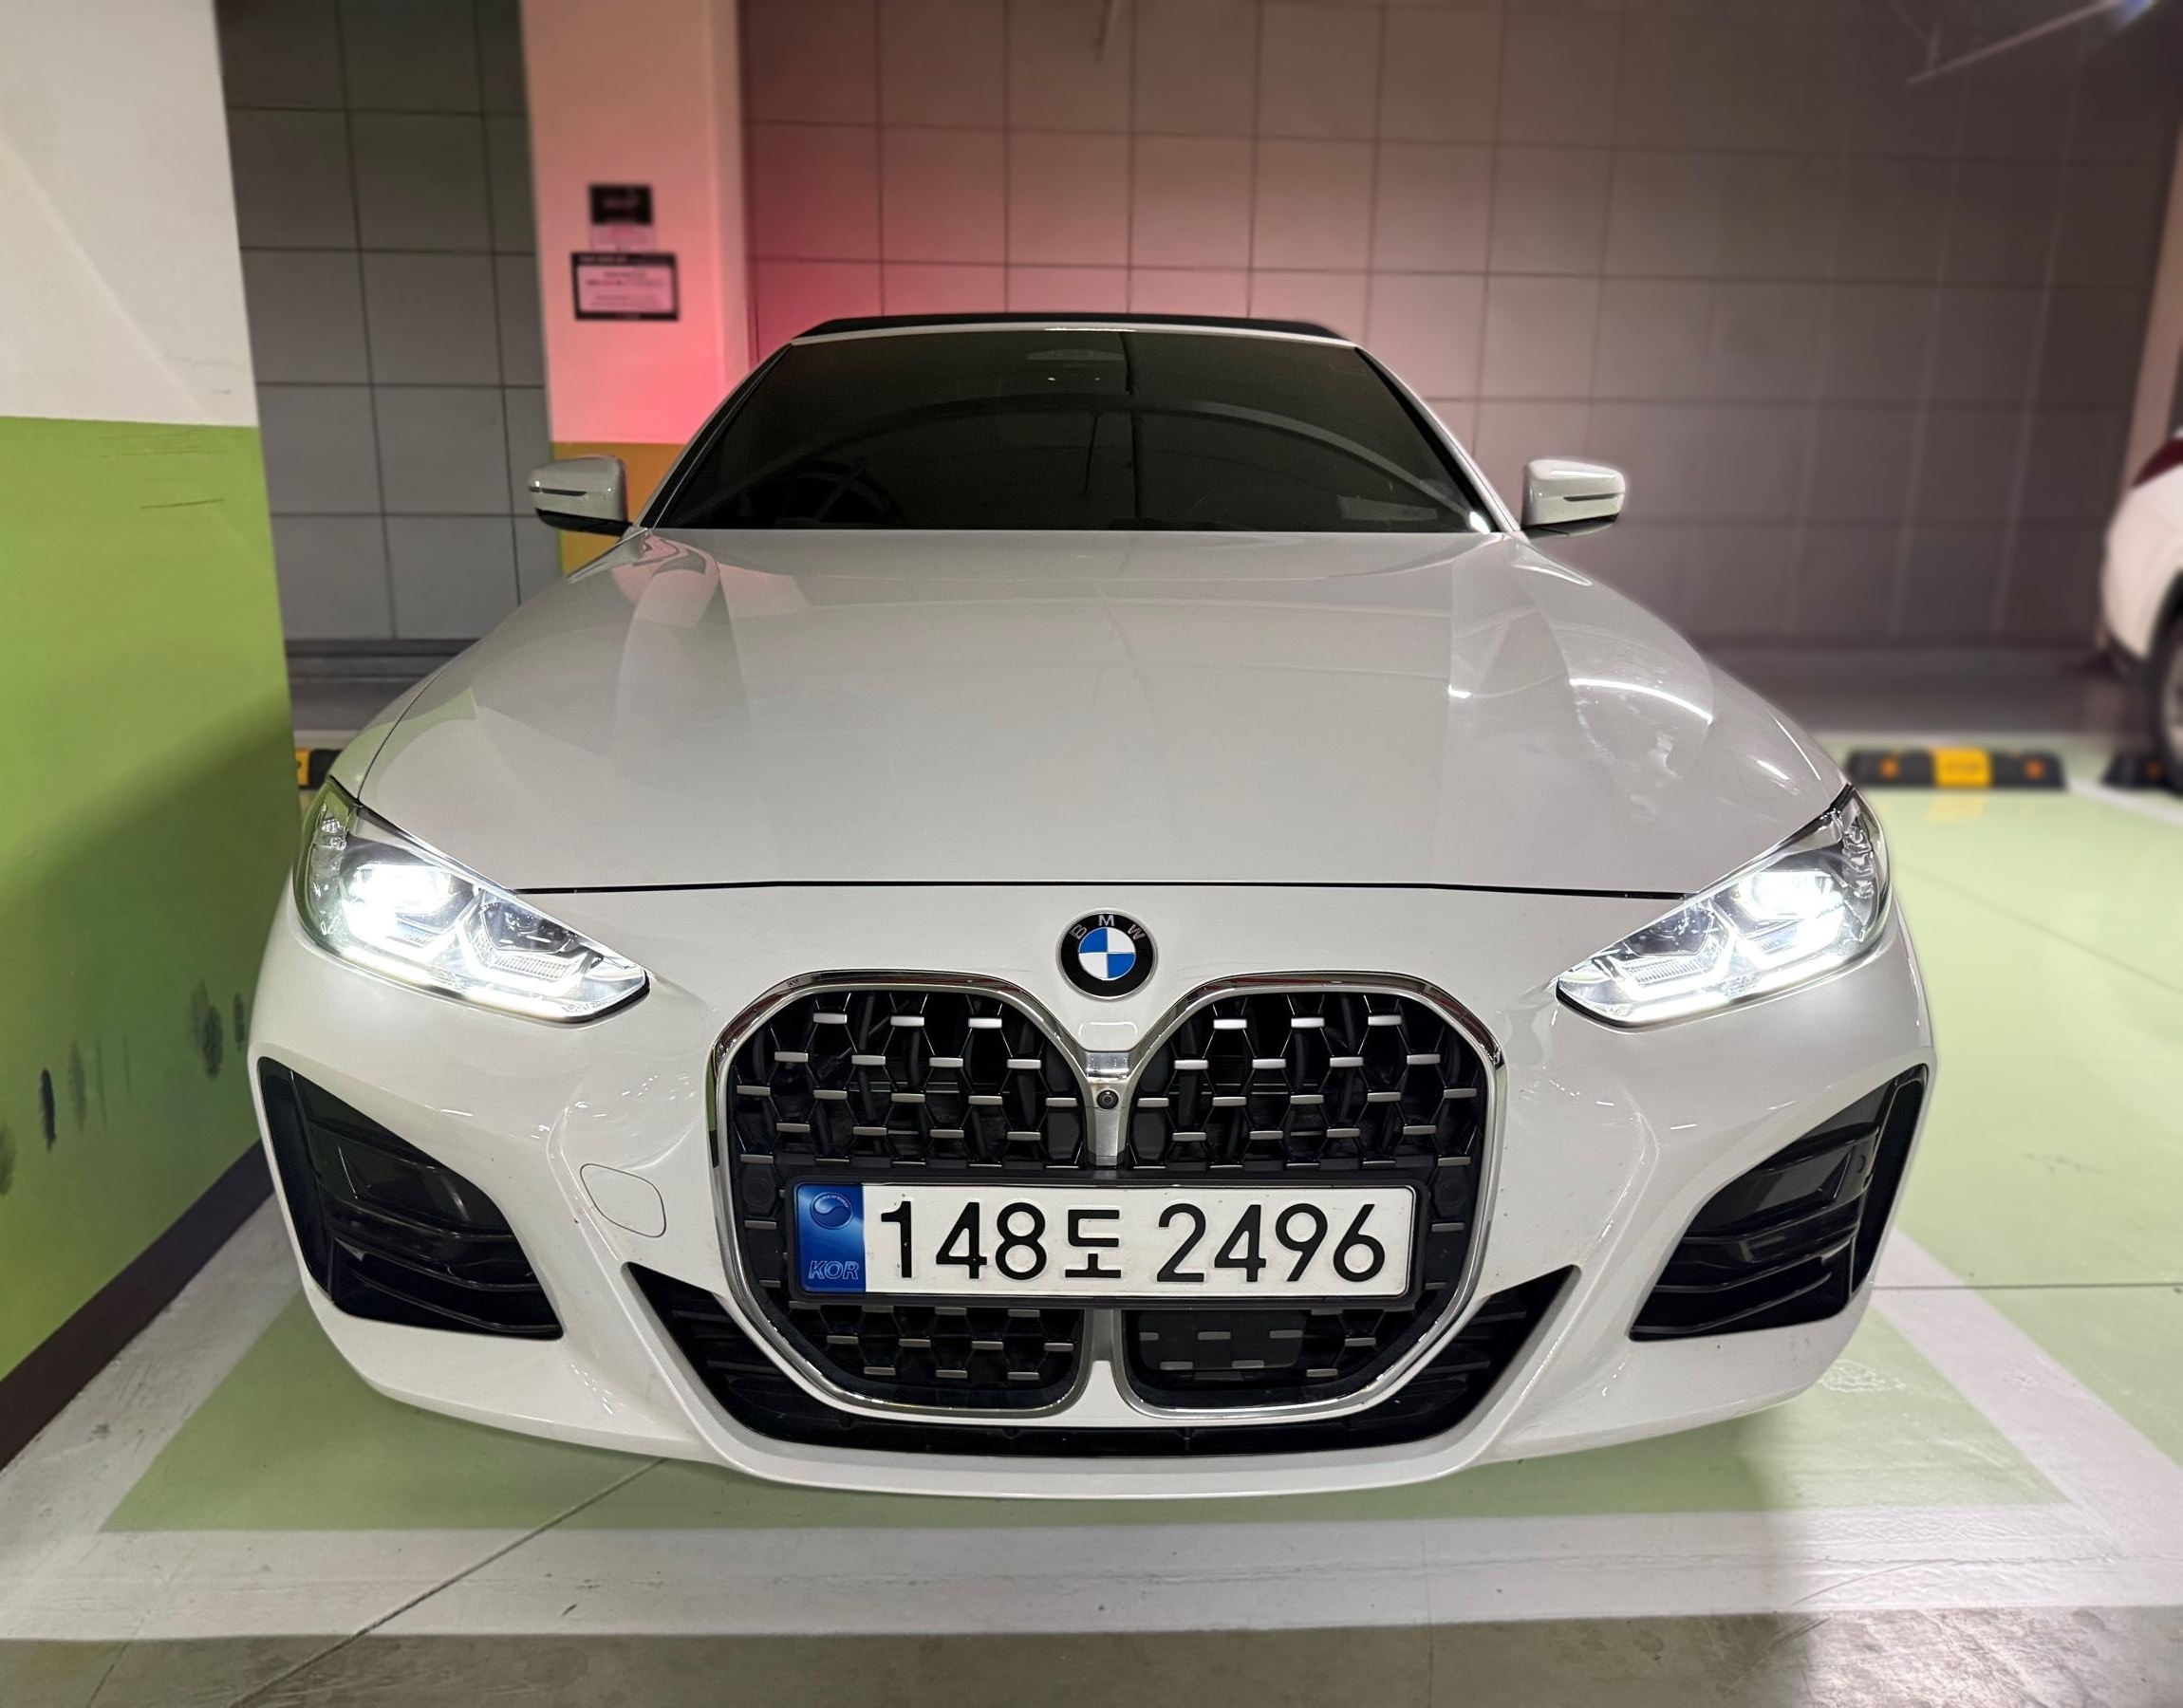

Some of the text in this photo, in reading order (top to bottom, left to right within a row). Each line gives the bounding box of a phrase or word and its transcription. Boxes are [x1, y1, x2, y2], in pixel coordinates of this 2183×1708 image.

[1069, 914, 1146, 940] BMW
[881, 1201, 1385, 1282] 148도 2496
[808, 1260, 860, 1280] KOR
